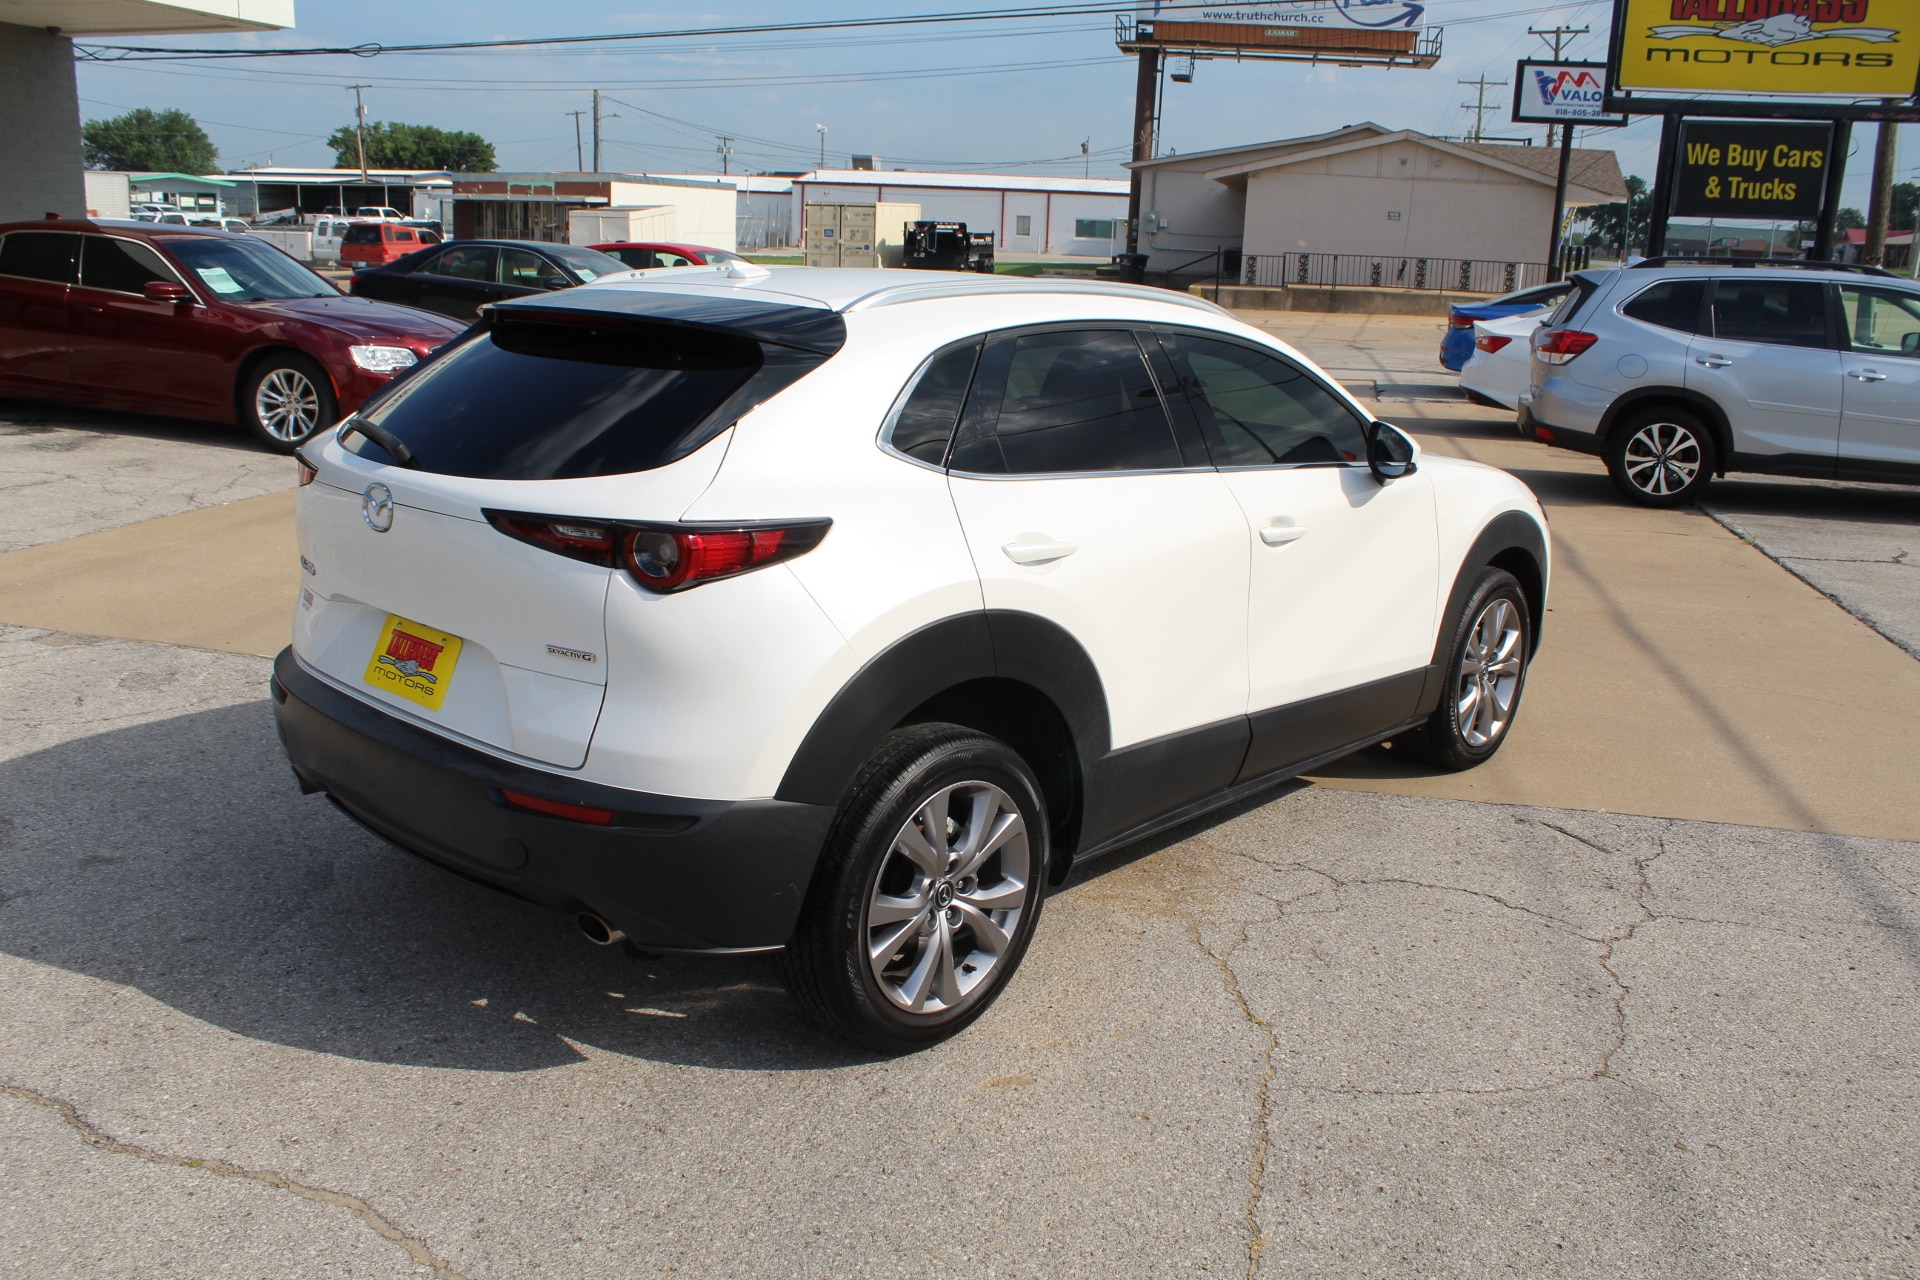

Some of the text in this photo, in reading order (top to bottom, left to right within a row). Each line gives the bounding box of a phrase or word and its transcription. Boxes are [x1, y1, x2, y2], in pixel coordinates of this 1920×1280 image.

[1202, 10, 1324, 23] www.truthchurch.cc
[1646, 47, 1894, 67] MOTORS
[1561, 90, 1603, 102] VALO
[1687, 142, 1824, 172] We Buy Cars
[1704, 175, 1797, 201] & Trucks
[373, 665, 435, 696] MOTORS
